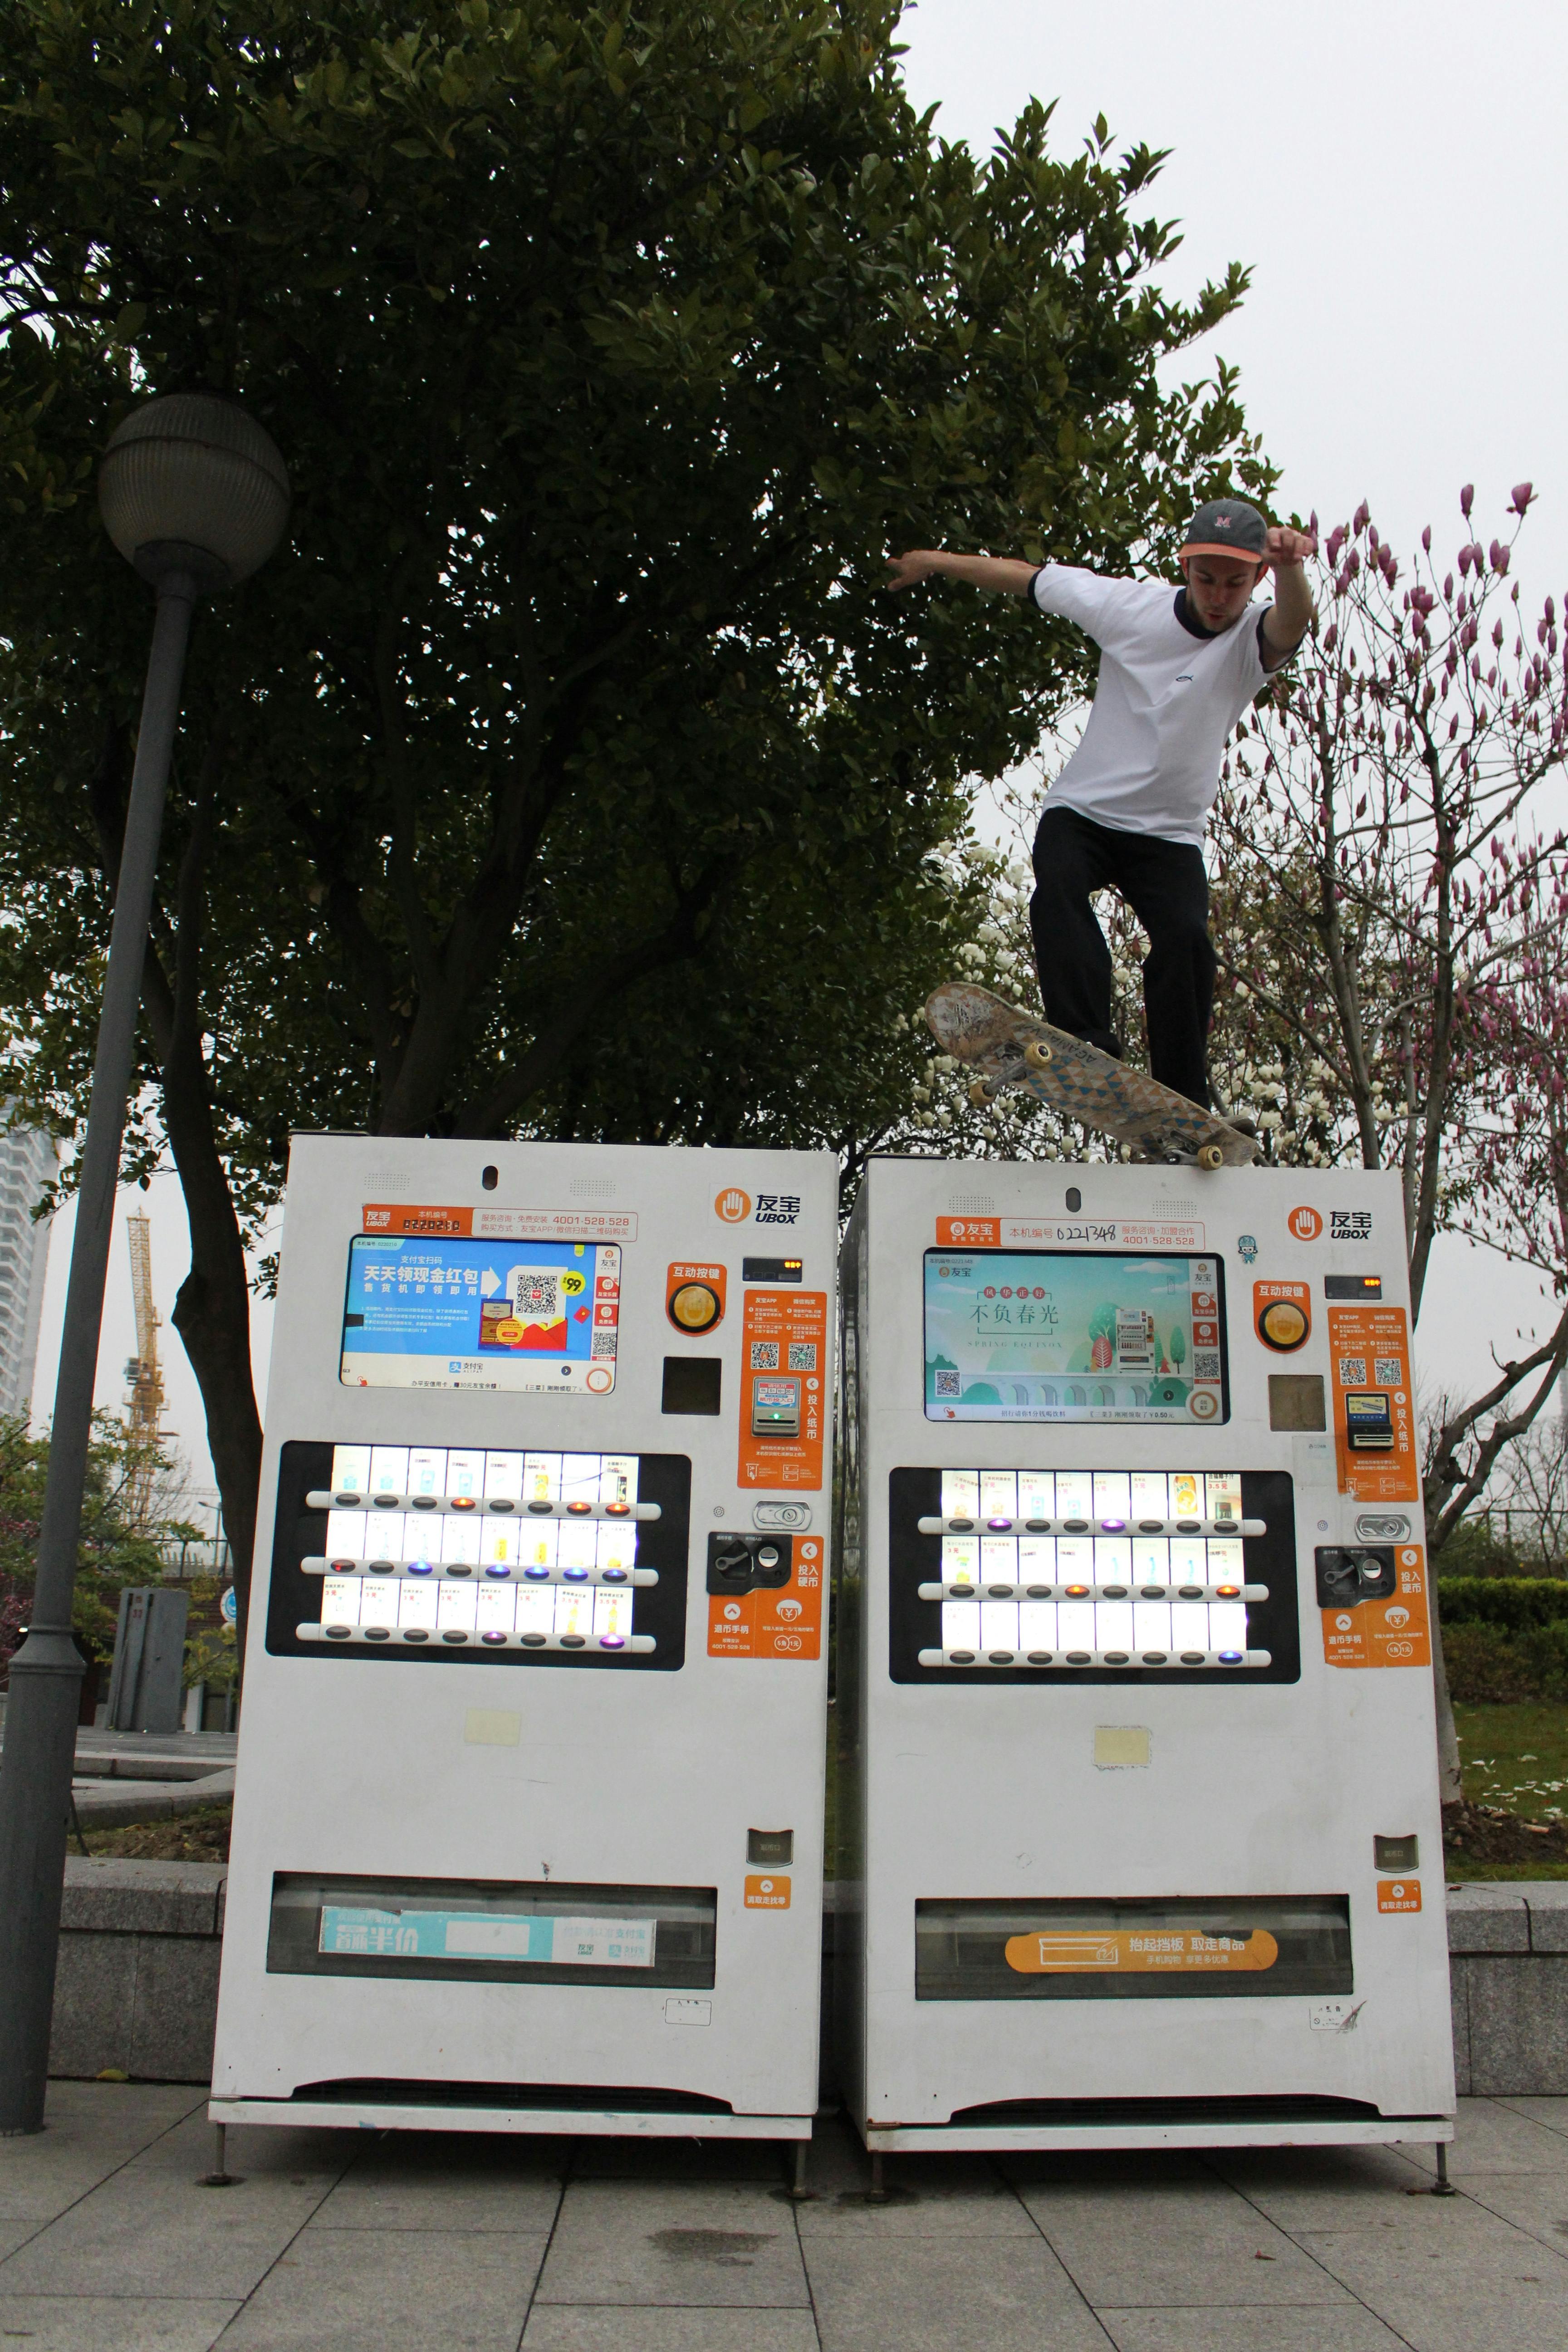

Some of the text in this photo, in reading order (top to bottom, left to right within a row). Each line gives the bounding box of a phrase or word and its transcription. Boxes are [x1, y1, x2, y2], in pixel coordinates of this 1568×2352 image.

[1215, 516, 1231, 527] M
[756, 1194, 801, 1213] 友宝
[366, 1211, 391, 1221] 友宝
[418, 1210, 447, 1219] 本机编号
[755, 1213, 799, 1224] UBOX
[1330, 1211, 1372, 1228] 友宝
[553, 1216, 630, 1226] 4001·528·528
[967, 1223, 994, 1235] 友宝
[1009, 1227, 1053, 1239] 本机编号
[1057, 1225, 1116, 1242] 0221348
[1330, 1229, 1371, 1240] UBOX
[1122, 1236, 1195, 1245] 4001·528·528
[401, 1255, 443, 1265] 支付宝扫码
[363, 1265, 479, 1285] 天天领现金红包
[673, 1266, 720, 1279] 互动按键
[951, 1268, 971, 1277] 友宝
[1195, 1274, 1211, 1282] 友宝
[364, 1282, 477, 1296] 售货机即领即用
[1259, 1285, 1304, 1298] 互动按键
[969, 1304, 1059, 1324] 不负春光
[806, 1394, 818, 1440] 投入纸币
[1396, 1408, 1409, 1452] 投入纸币
[798, 1564, 819, 1576] 投入
[1401, 1571, 1421, 1582] 投入
[797, 1577, 818, 1588] 硬币
[1401, 1582, 1421, 1593] 硬币
[714, 1624, 749, 1634] 退币手柄
[1328, 1635, 1362, 1645] 退币手柄
[1129, 1936, 1245, 1952] 抬起挡板 取走商品
[1147, 1955, 1229, 1965] 手机购物 享更多优惠
